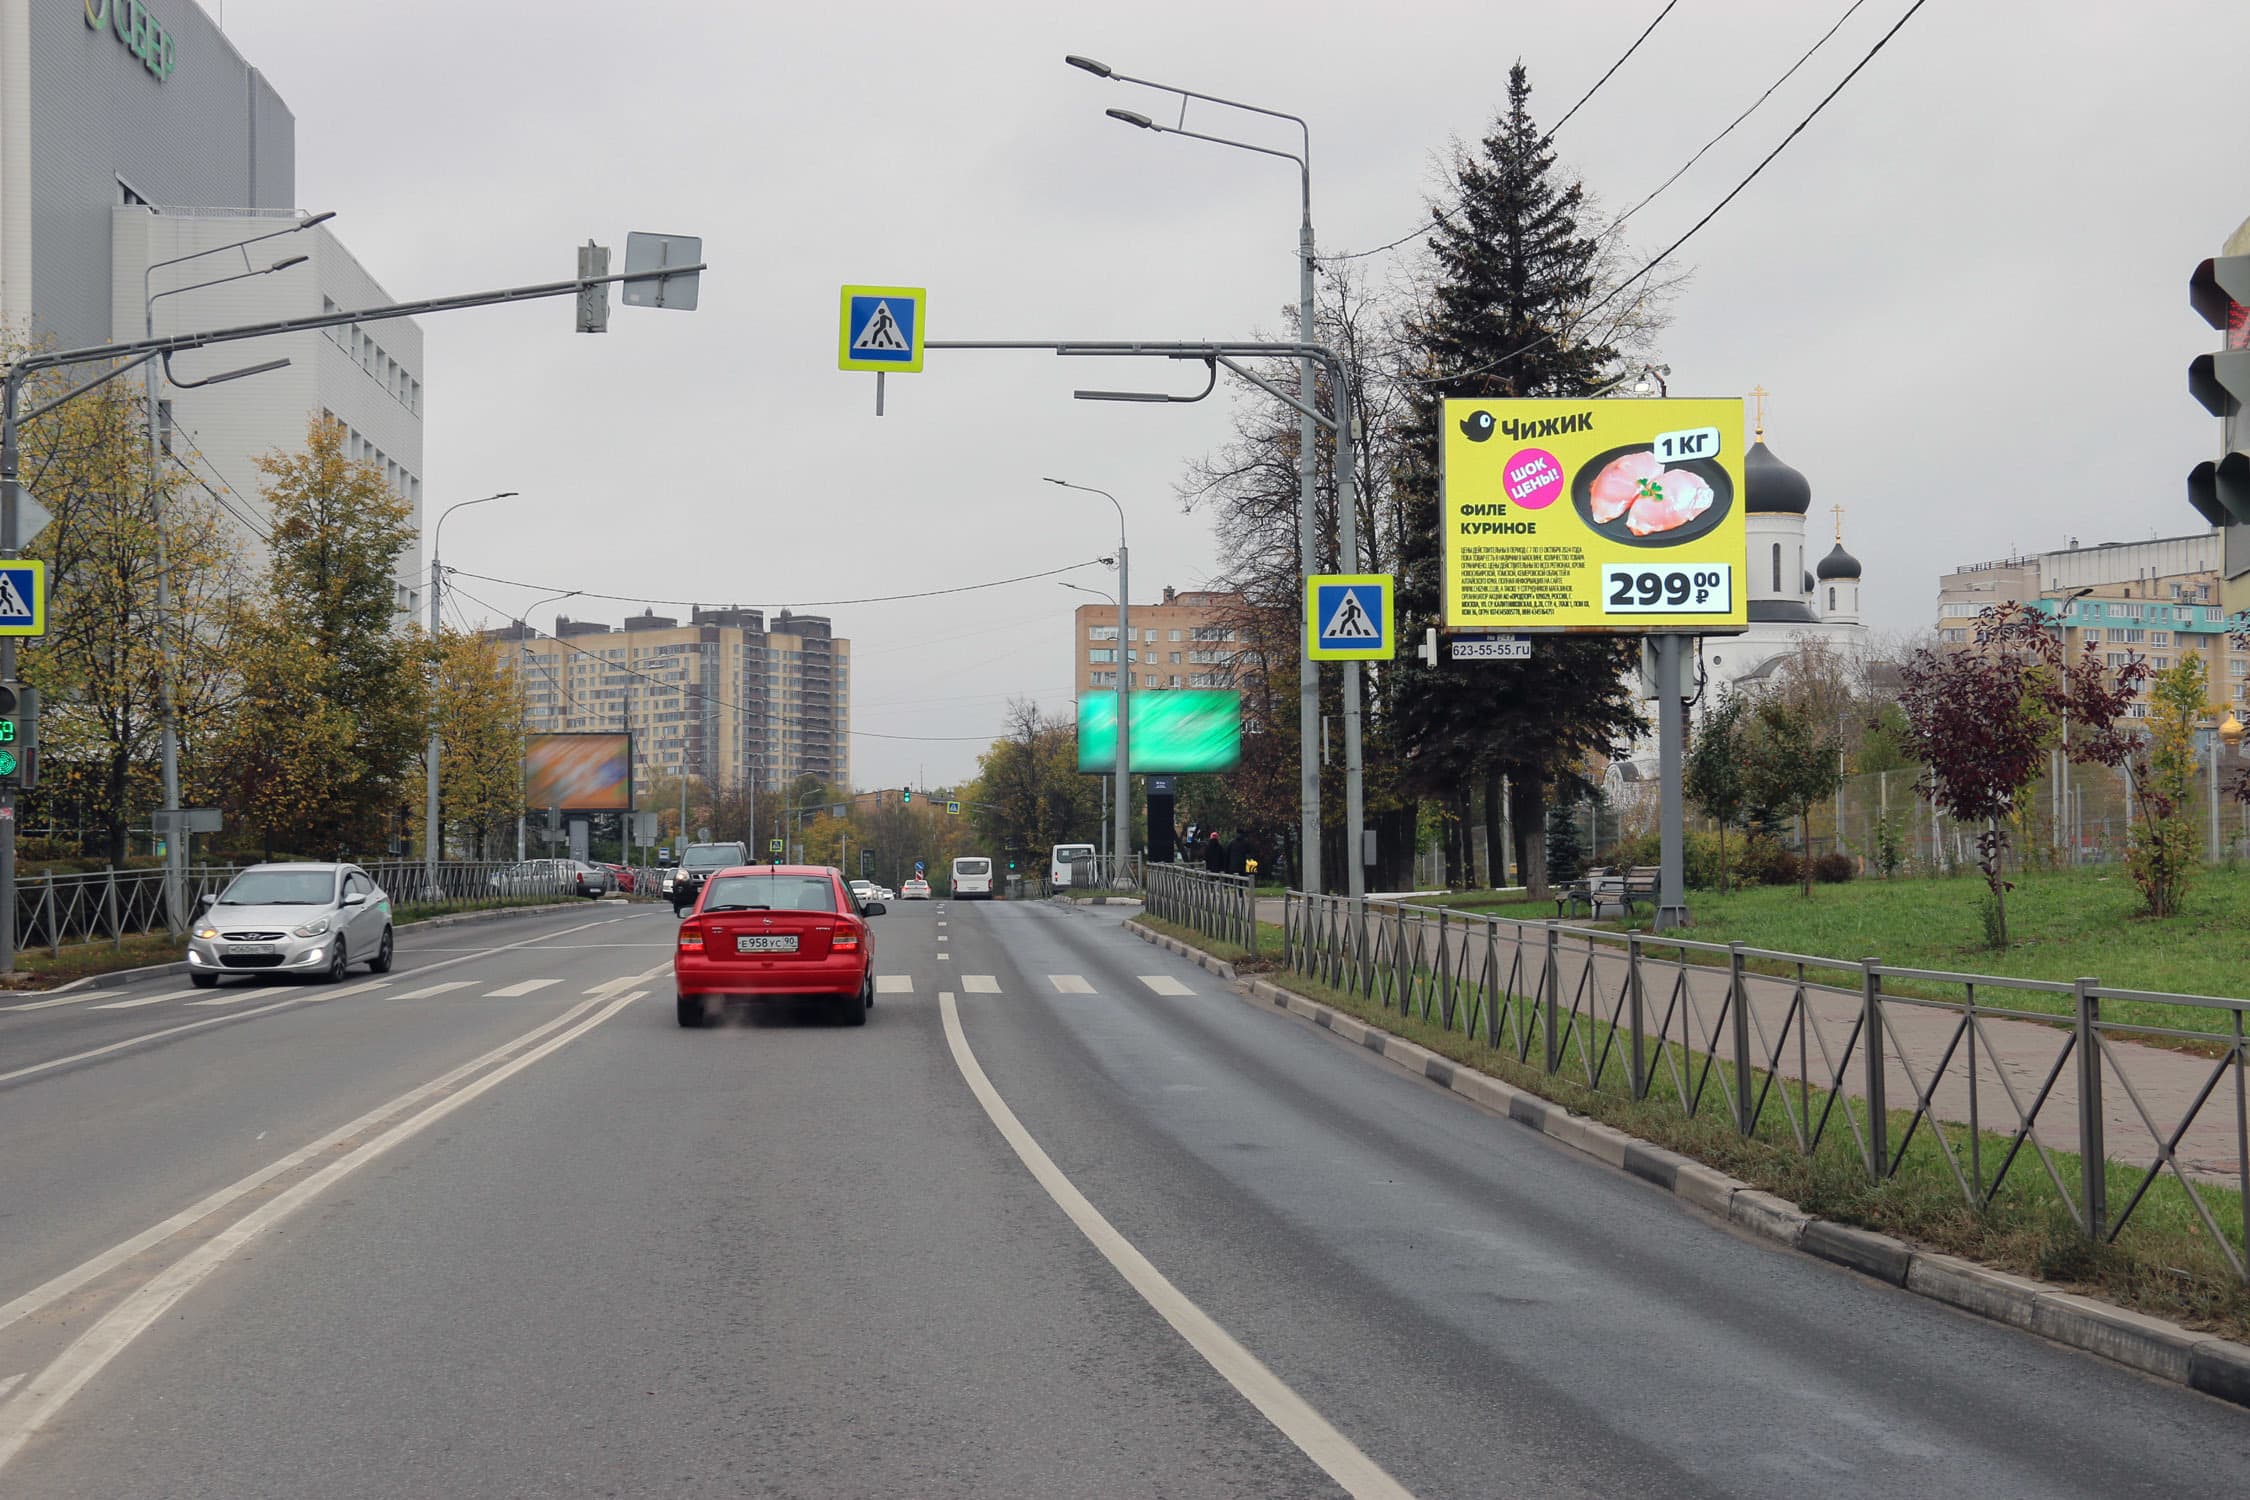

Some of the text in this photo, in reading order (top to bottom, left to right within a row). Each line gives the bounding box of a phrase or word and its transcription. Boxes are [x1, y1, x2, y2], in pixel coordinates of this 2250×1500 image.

[112, 0, 176, 80] СБЕР
[1662, 433, 1709, 456] 1 КГ
[1510, 456, 1548, 482] ШОК
[1511, 467, 1560, 499] ЦЕНЫ!
[1460, 504, 1506, 516] ФИЛЕ
[1461, 522, 1536, 534] КУРИНОЕ
[1610, 572, 1720, 605] 299 00
[1453, 644, 1530, 656] 623-55-55.ru
